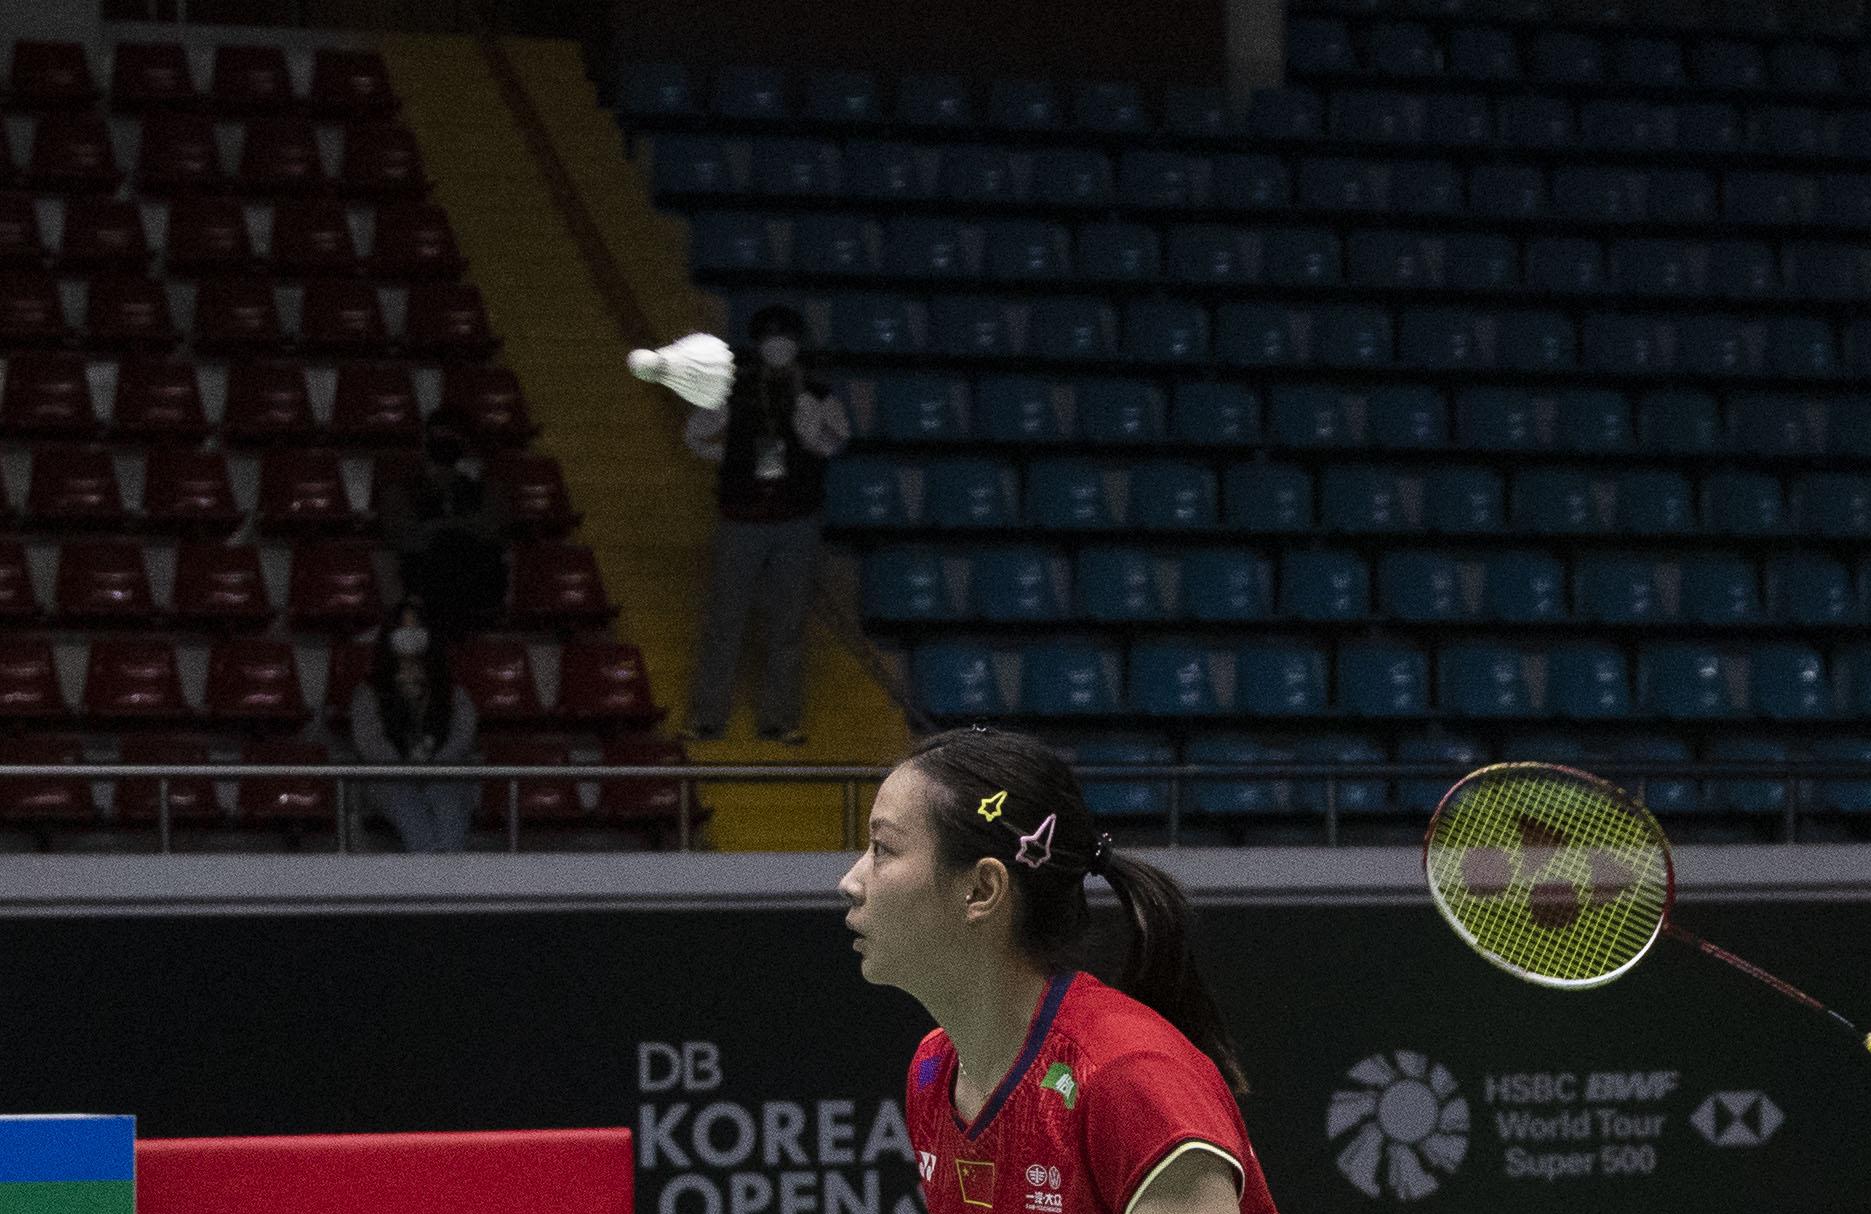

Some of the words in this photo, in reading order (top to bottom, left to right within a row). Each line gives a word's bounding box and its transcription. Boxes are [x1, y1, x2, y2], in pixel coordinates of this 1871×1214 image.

[638, 1041, 722, 1092] DB
[1485, 1071, 1577, 1102] HSBC
[1585, 1070, 1680, 1099] BWF
[638, 1100, 918, 1168] KOREA
[1498, 1109, 1592, 1139] World
[1597, 1108, 1667, 1137] Tour
[1505, 1145, 1596, 1182] Super
[1600, 1144, 1657, 1174] 500
